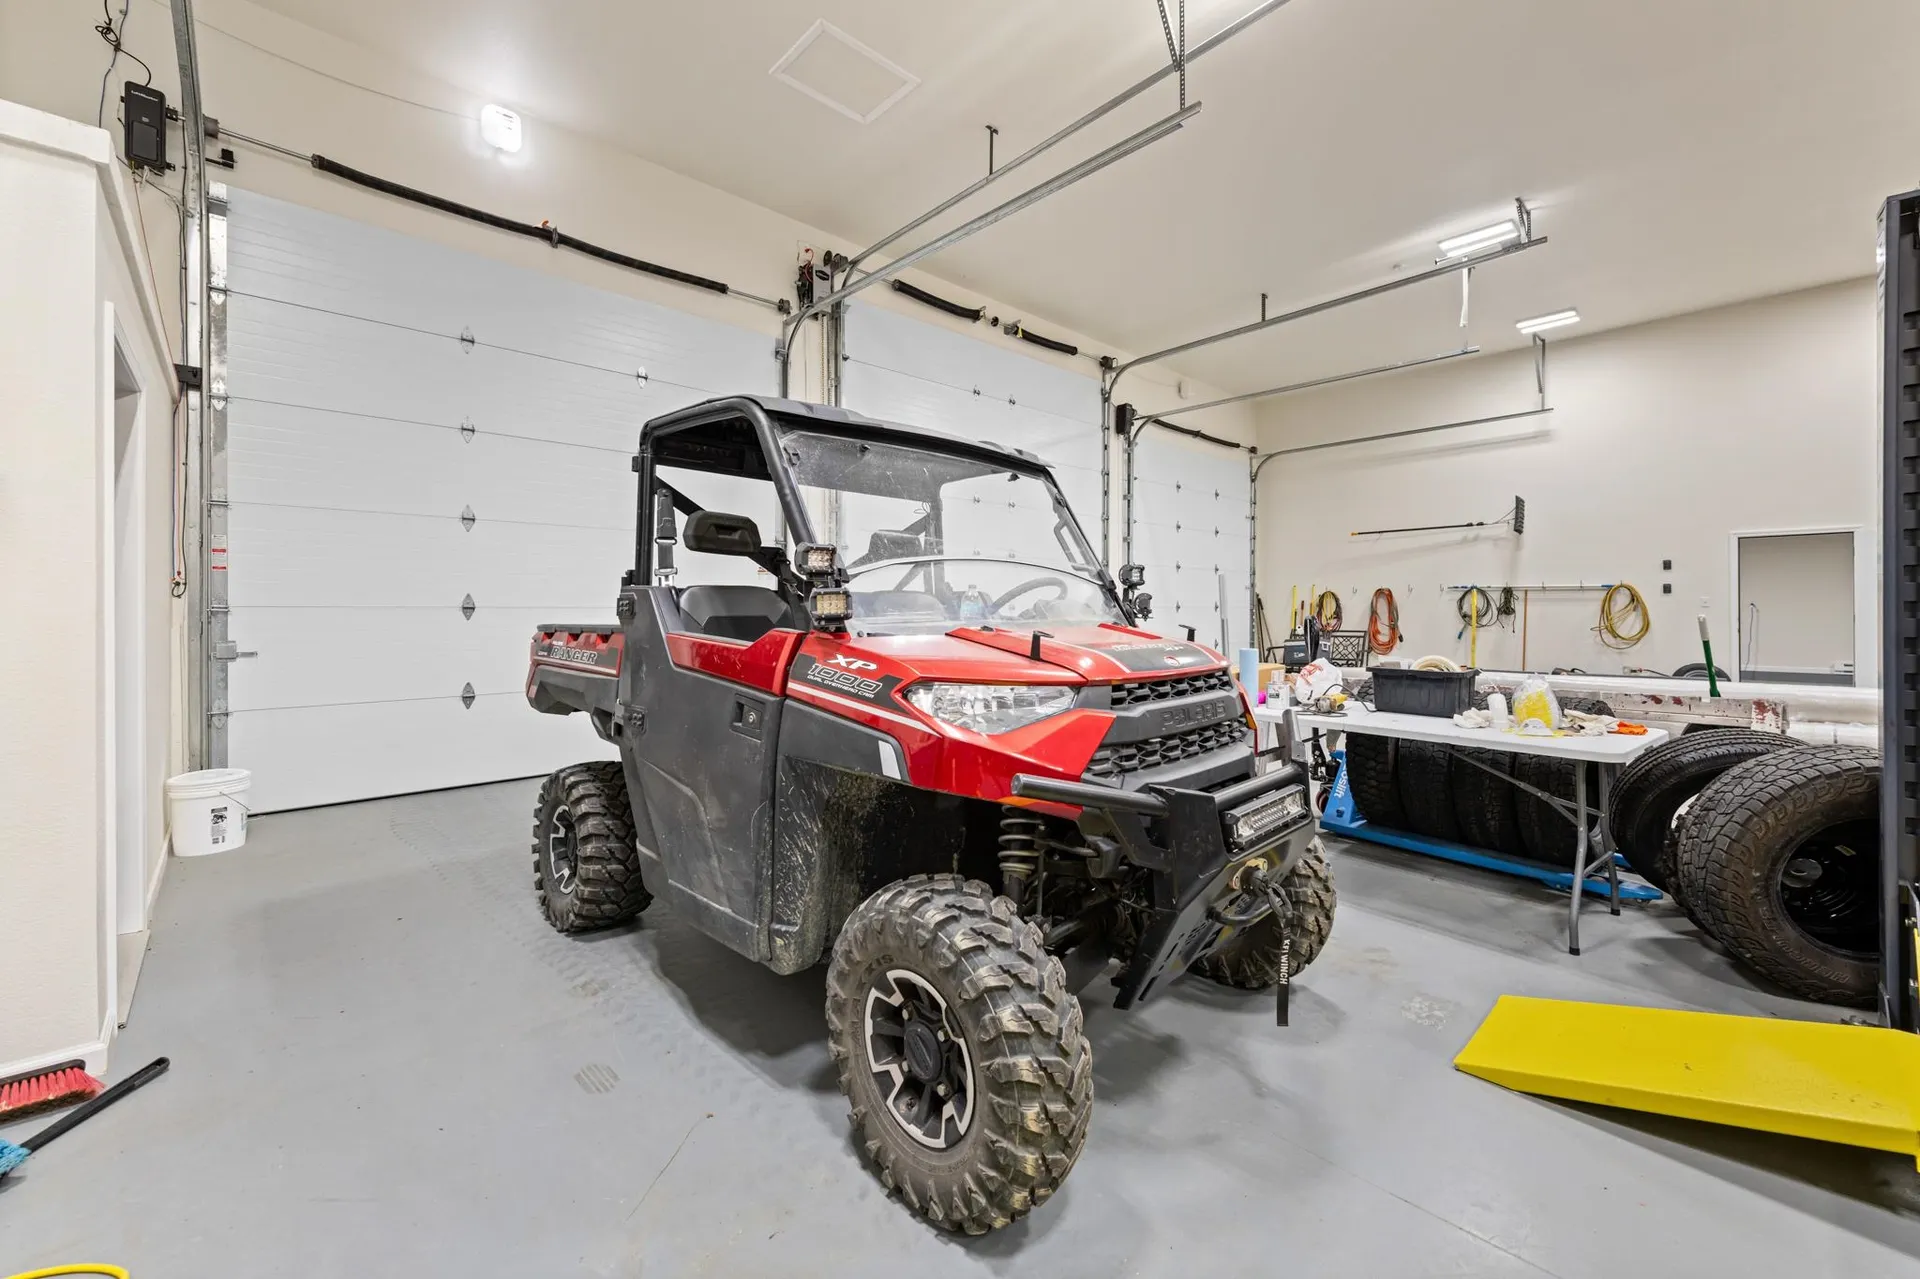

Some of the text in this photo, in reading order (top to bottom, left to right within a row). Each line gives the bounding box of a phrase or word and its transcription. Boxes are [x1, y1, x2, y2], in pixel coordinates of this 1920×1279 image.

[550, 646, 597, 664] RANGER
[826, 653, 877, 670] XP
[807, 675, 875, 699] DUAL OVERHEAD CAM
[808, 663, 883, 694] 1000
[1160, 700, 1226, 728] POLARIS
[1333, 763, 1348, 798] oslift
[1280, 939, 1291, 985] KFI WINCH
